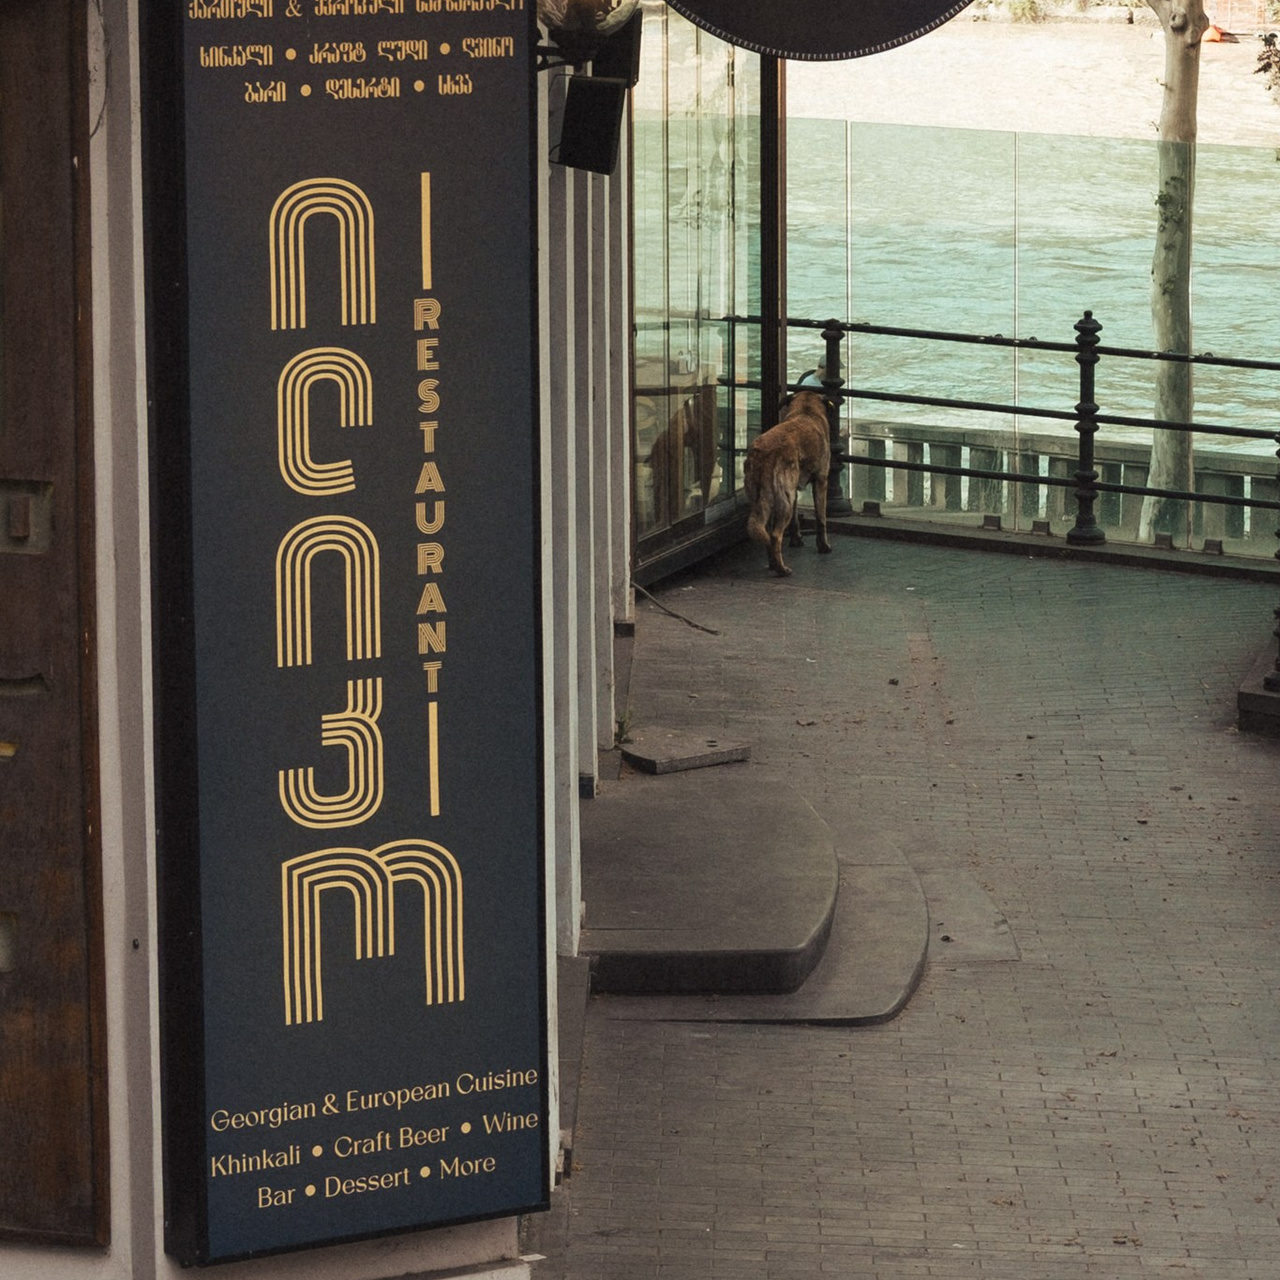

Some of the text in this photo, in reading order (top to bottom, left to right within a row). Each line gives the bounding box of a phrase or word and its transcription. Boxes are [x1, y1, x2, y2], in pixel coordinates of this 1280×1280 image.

[200, 36, 514, 68] ხინკალი კრაფტ ლუდი ღვინო
[244, 73, 473, 104] ბარი დესერტი სხვა
[413, 297, 447, 693] RESTAURANT
[211, 1068, 538, 1132] Georgian & European Cuisine
[211, 1113, 538, 1177] Khinkali Craft Beer Wine
[258, 1155, 496, 1209] Bar Dessert More
